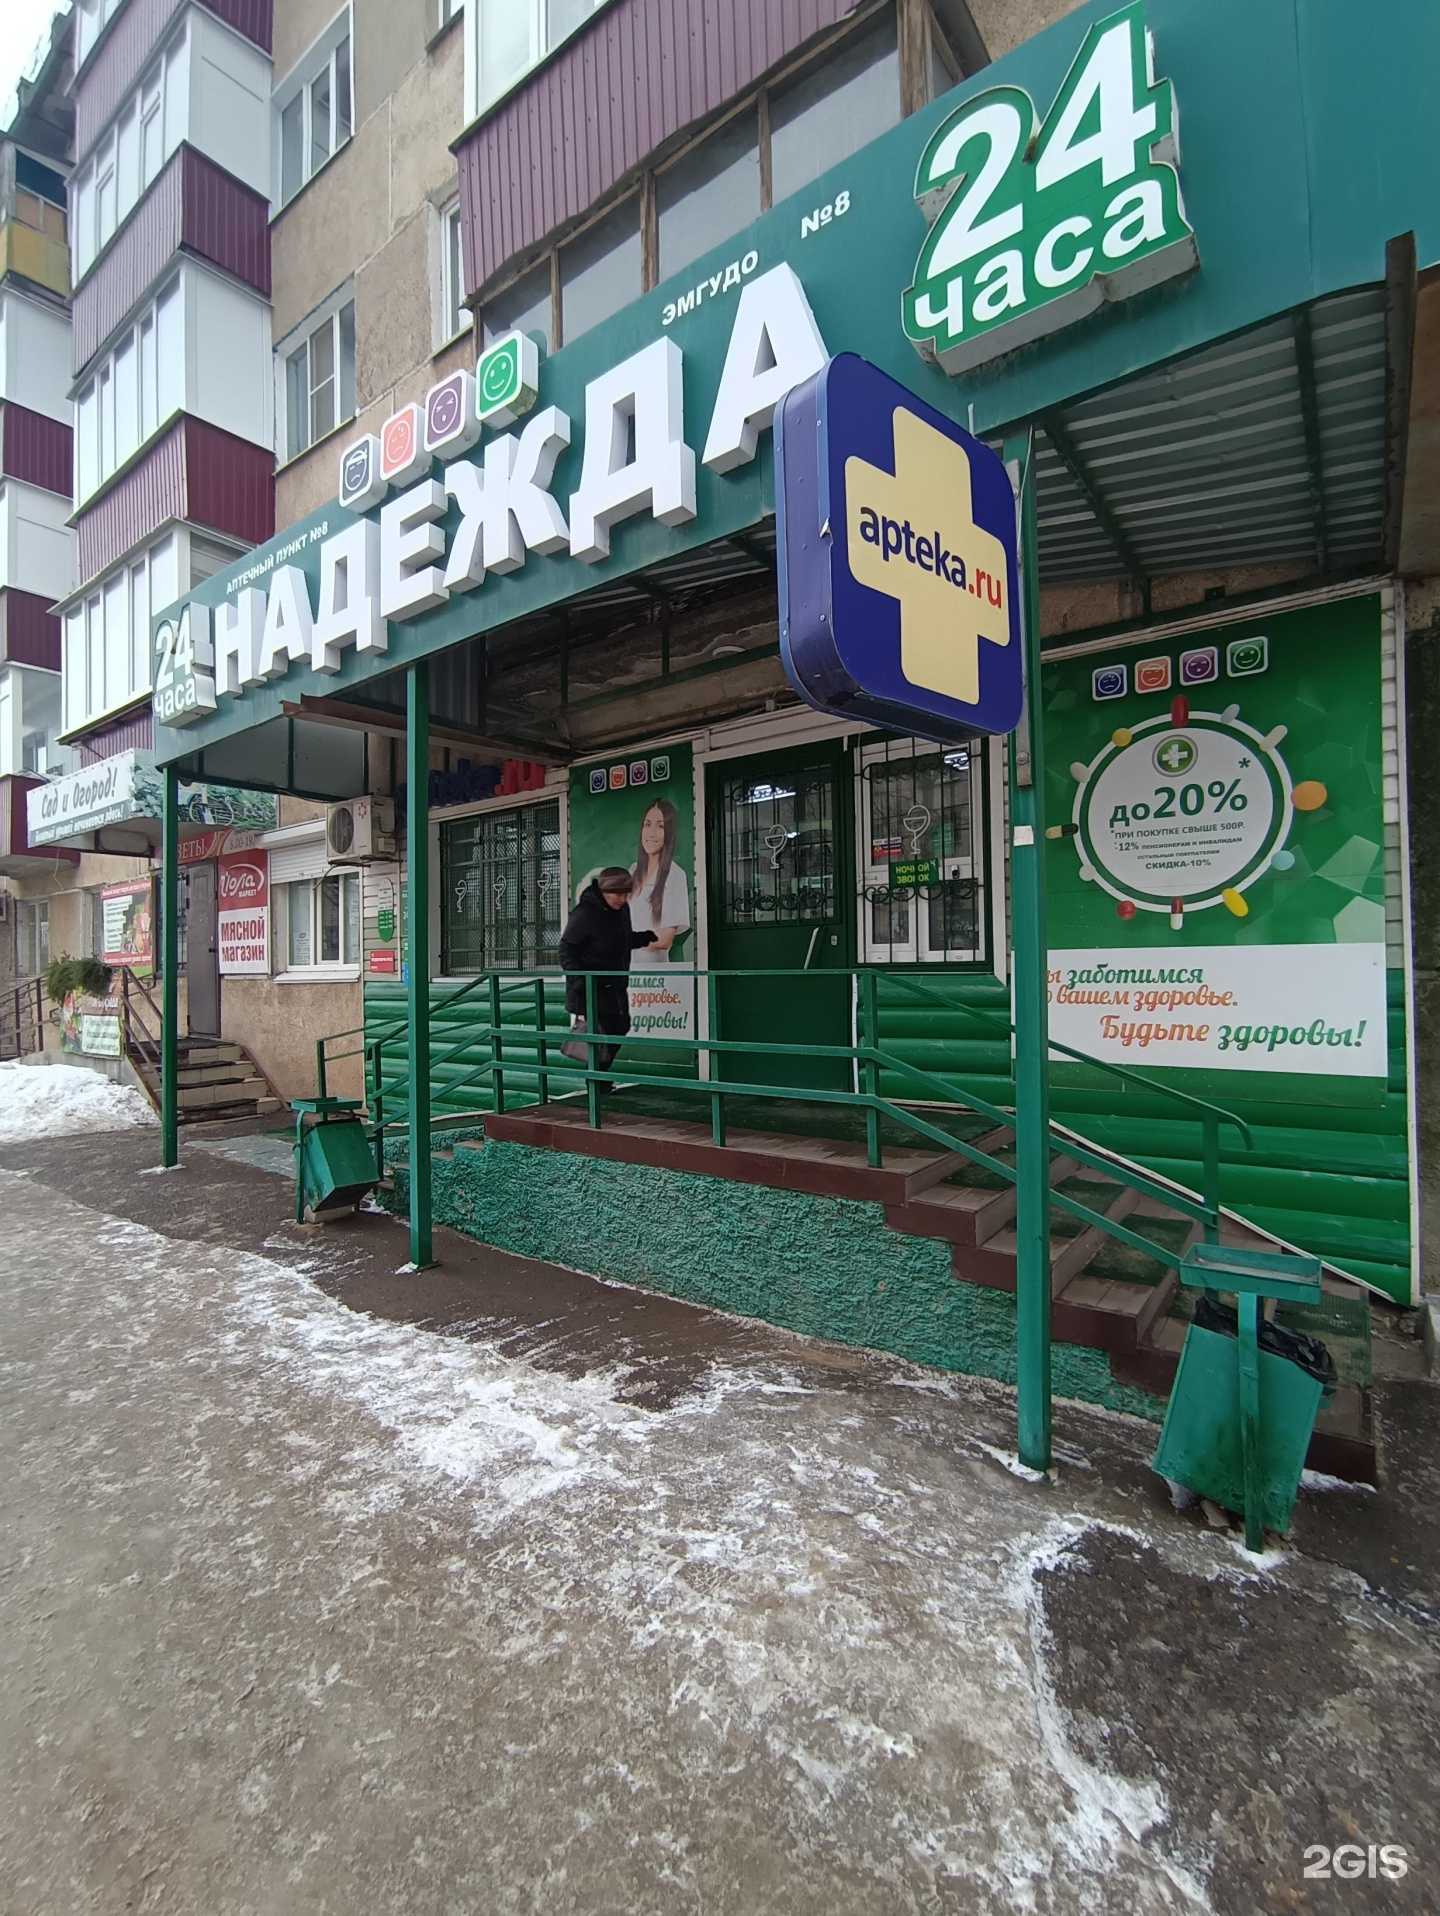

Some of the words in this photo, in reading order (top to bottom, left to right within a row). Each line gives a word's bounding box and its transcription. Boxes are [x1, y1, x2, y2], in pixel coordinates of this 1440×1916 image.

[926, 19, 1156, 280] 24
[661, 250, 759, 326] ЭМГУДО
[800, 190, 850, 240] №8
[914, 179, 1167, 338] часа
[215, 261, 832, 698] НАДЕЖДА
[226, 553, 274, 595] АПТЕЧНЫЙ
[276, 533, 308, 565] ПУНКТ
[309, 520, 328, 543] №8
[859, 506, 1002, 609] apteka.ru
[154, 608, 194, 688] 24
[153, 677, 196, 719] часа
[41, 788, 59, 819] Сад
[62, 793, 69, 813] и
[73, 767, 118, 809] Огород!
[1136, 826, 1180, 838] ПОКУПКЕ
[1182, 823, 1218, 834] СВЫШЕ
[221, 916, 265, 942] МЯСНОЙ
[1056, 984, 1130, 1006] вашем
[1132, 984, 1239, 1012] здоровье.
[1066, 963, 1204, 990] заботимся
[632, 1011, 689, 1033] доровы!
[1099, 1014, 1210, 1047] Будьте
[1217, 1018, 1367, 1053] здоровы!
